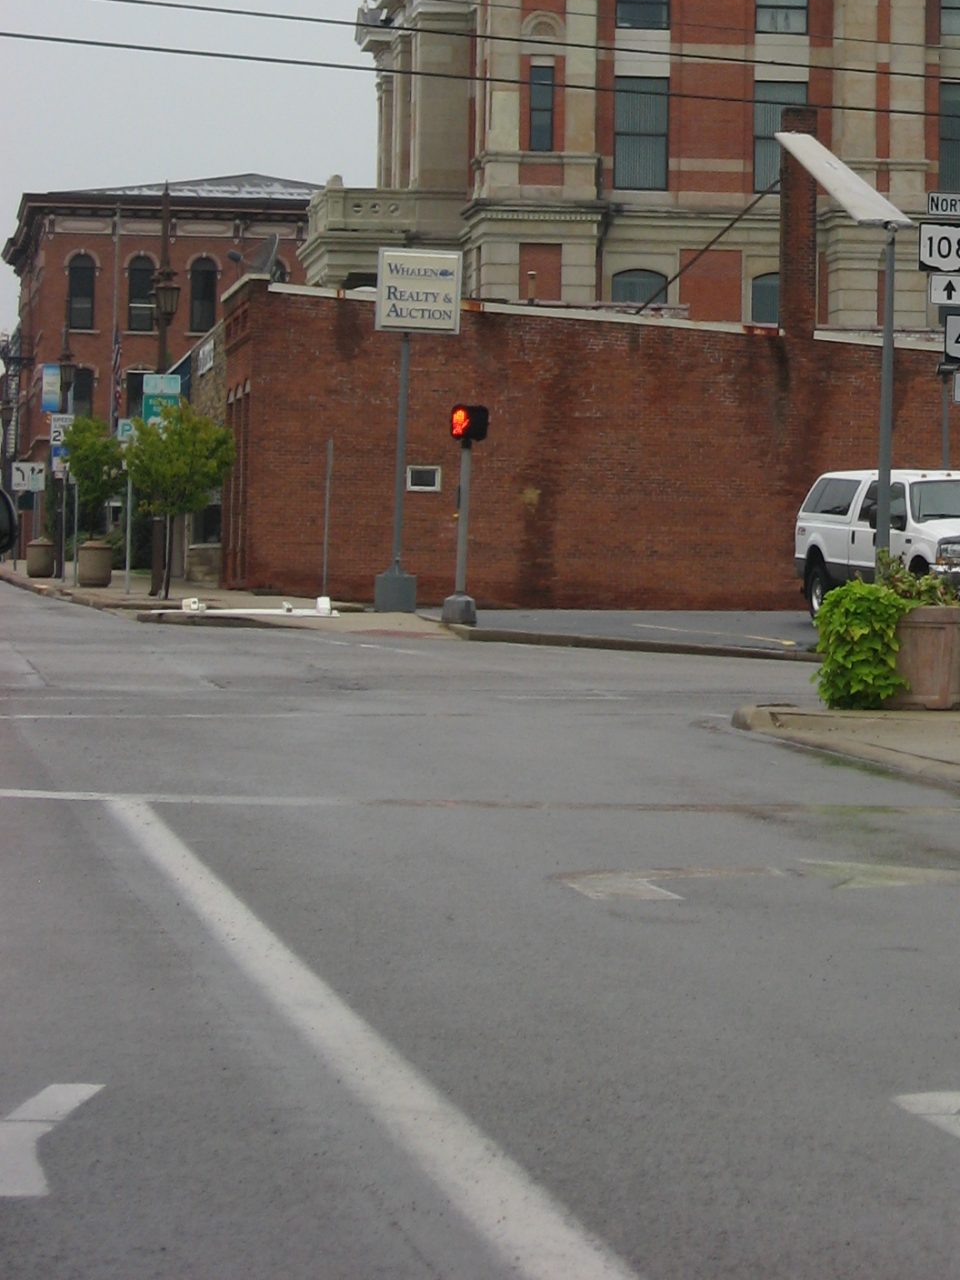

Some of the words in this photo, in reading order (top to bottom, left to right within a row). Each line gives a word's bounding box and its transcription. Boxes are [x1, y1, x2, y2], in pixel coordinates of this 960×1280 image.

[387, 262, 439, 278] WHALEN
[386, 285, 440, 303] REALTY
[442, 292, 453, 304] &
[386, 303, 453, 321] AUCTION
